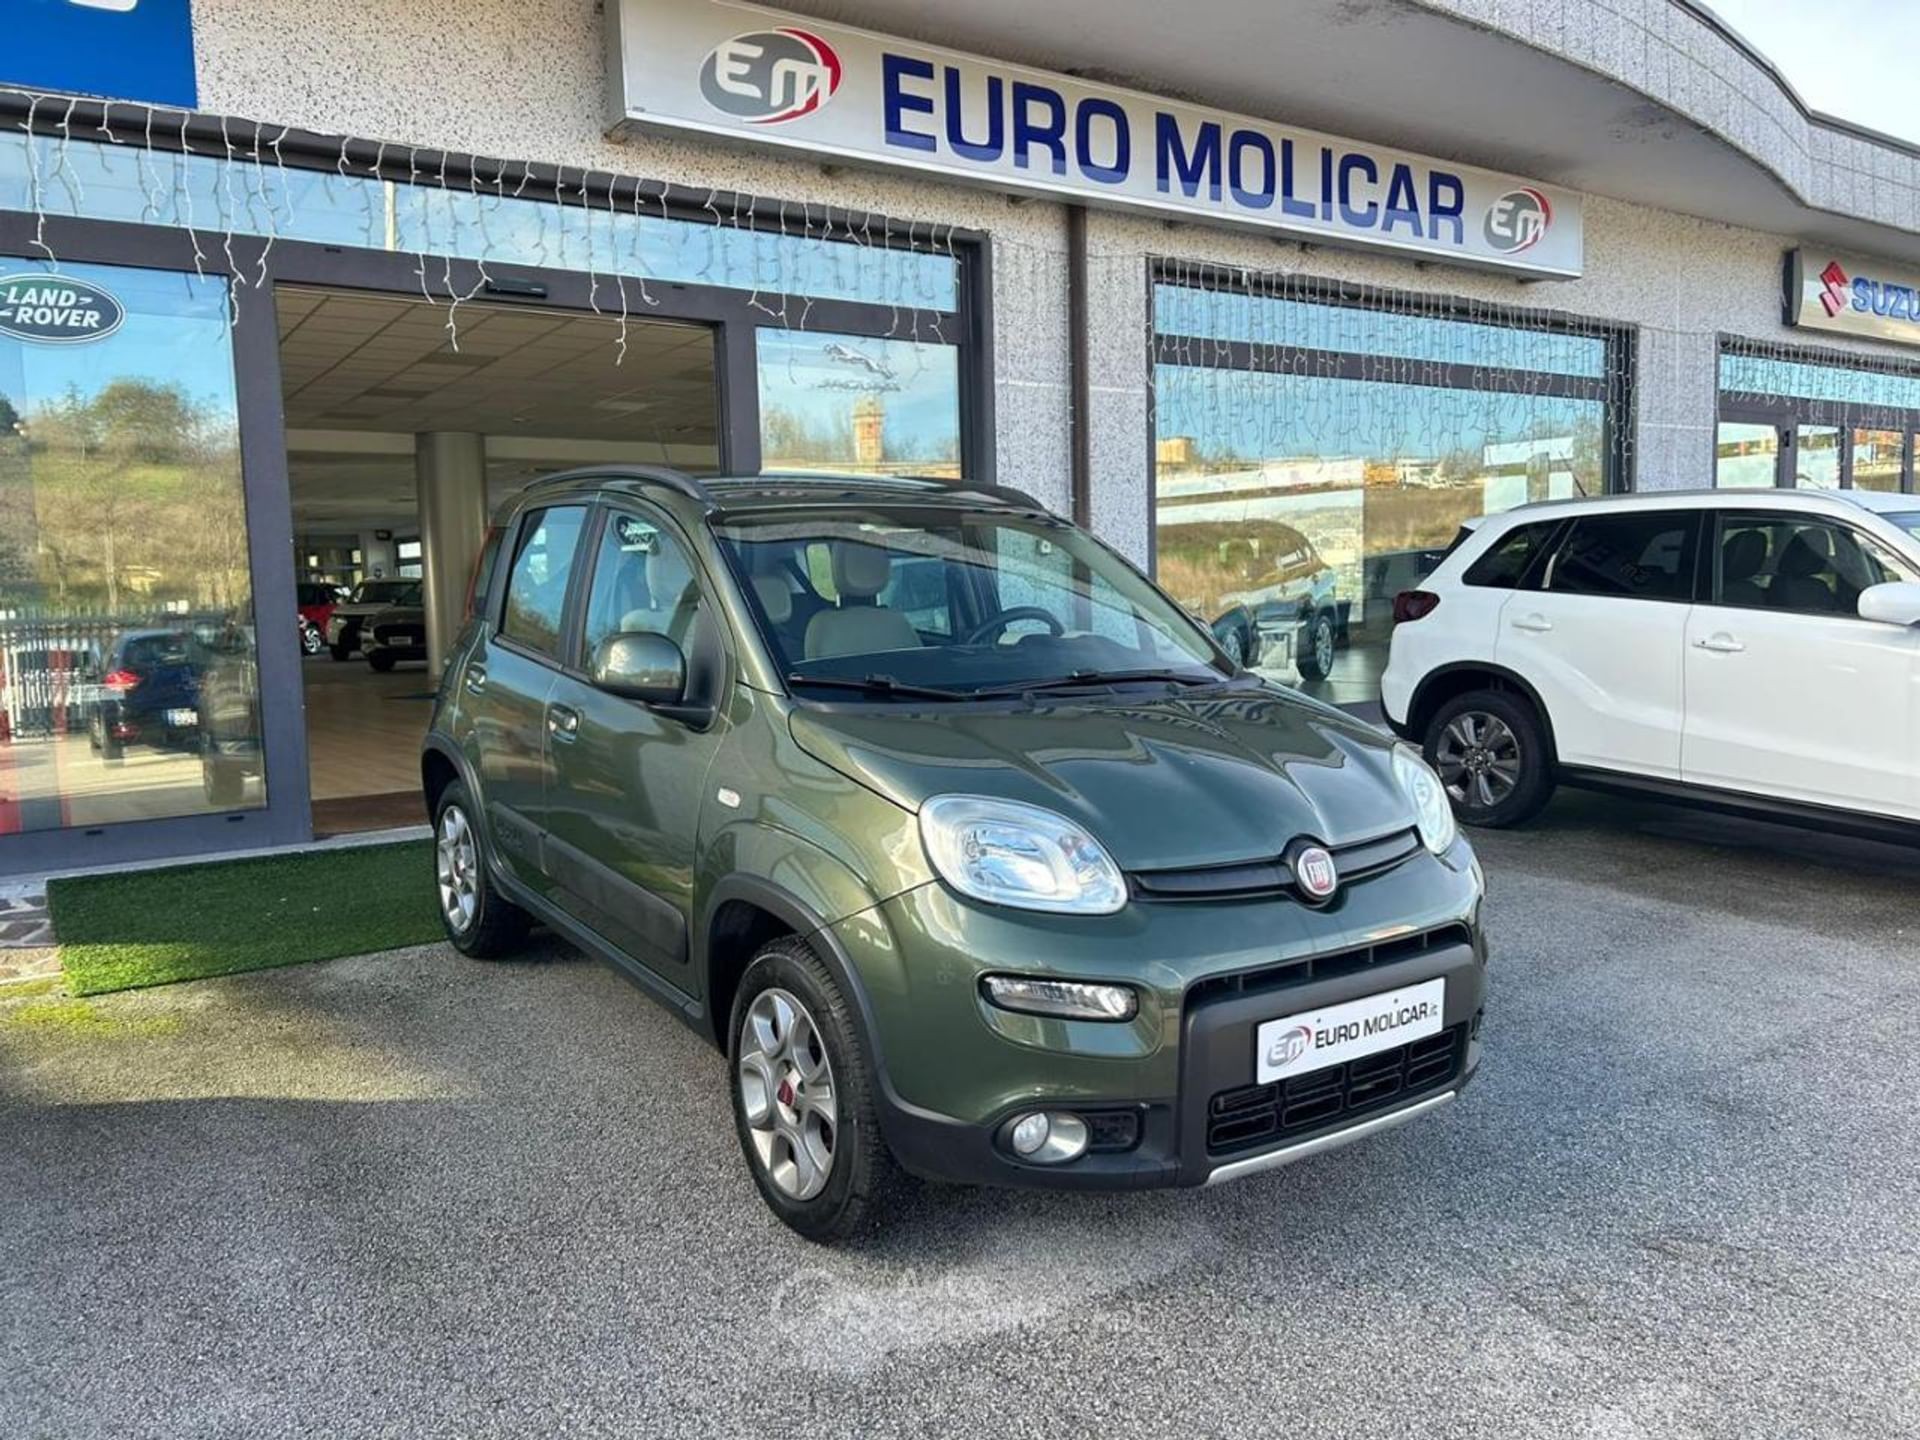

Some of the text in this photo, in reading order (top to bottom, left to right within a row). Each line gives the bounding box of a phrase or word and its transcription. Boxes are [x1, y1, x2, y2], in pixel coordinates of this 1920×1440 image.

[882, 53, 1464, 245] EURO MOLICAR
[6, 286, 77, 307] LAND
[14, 306, 101, 328] ROVER
[1315, 1022, 1359, 1049] EURO
